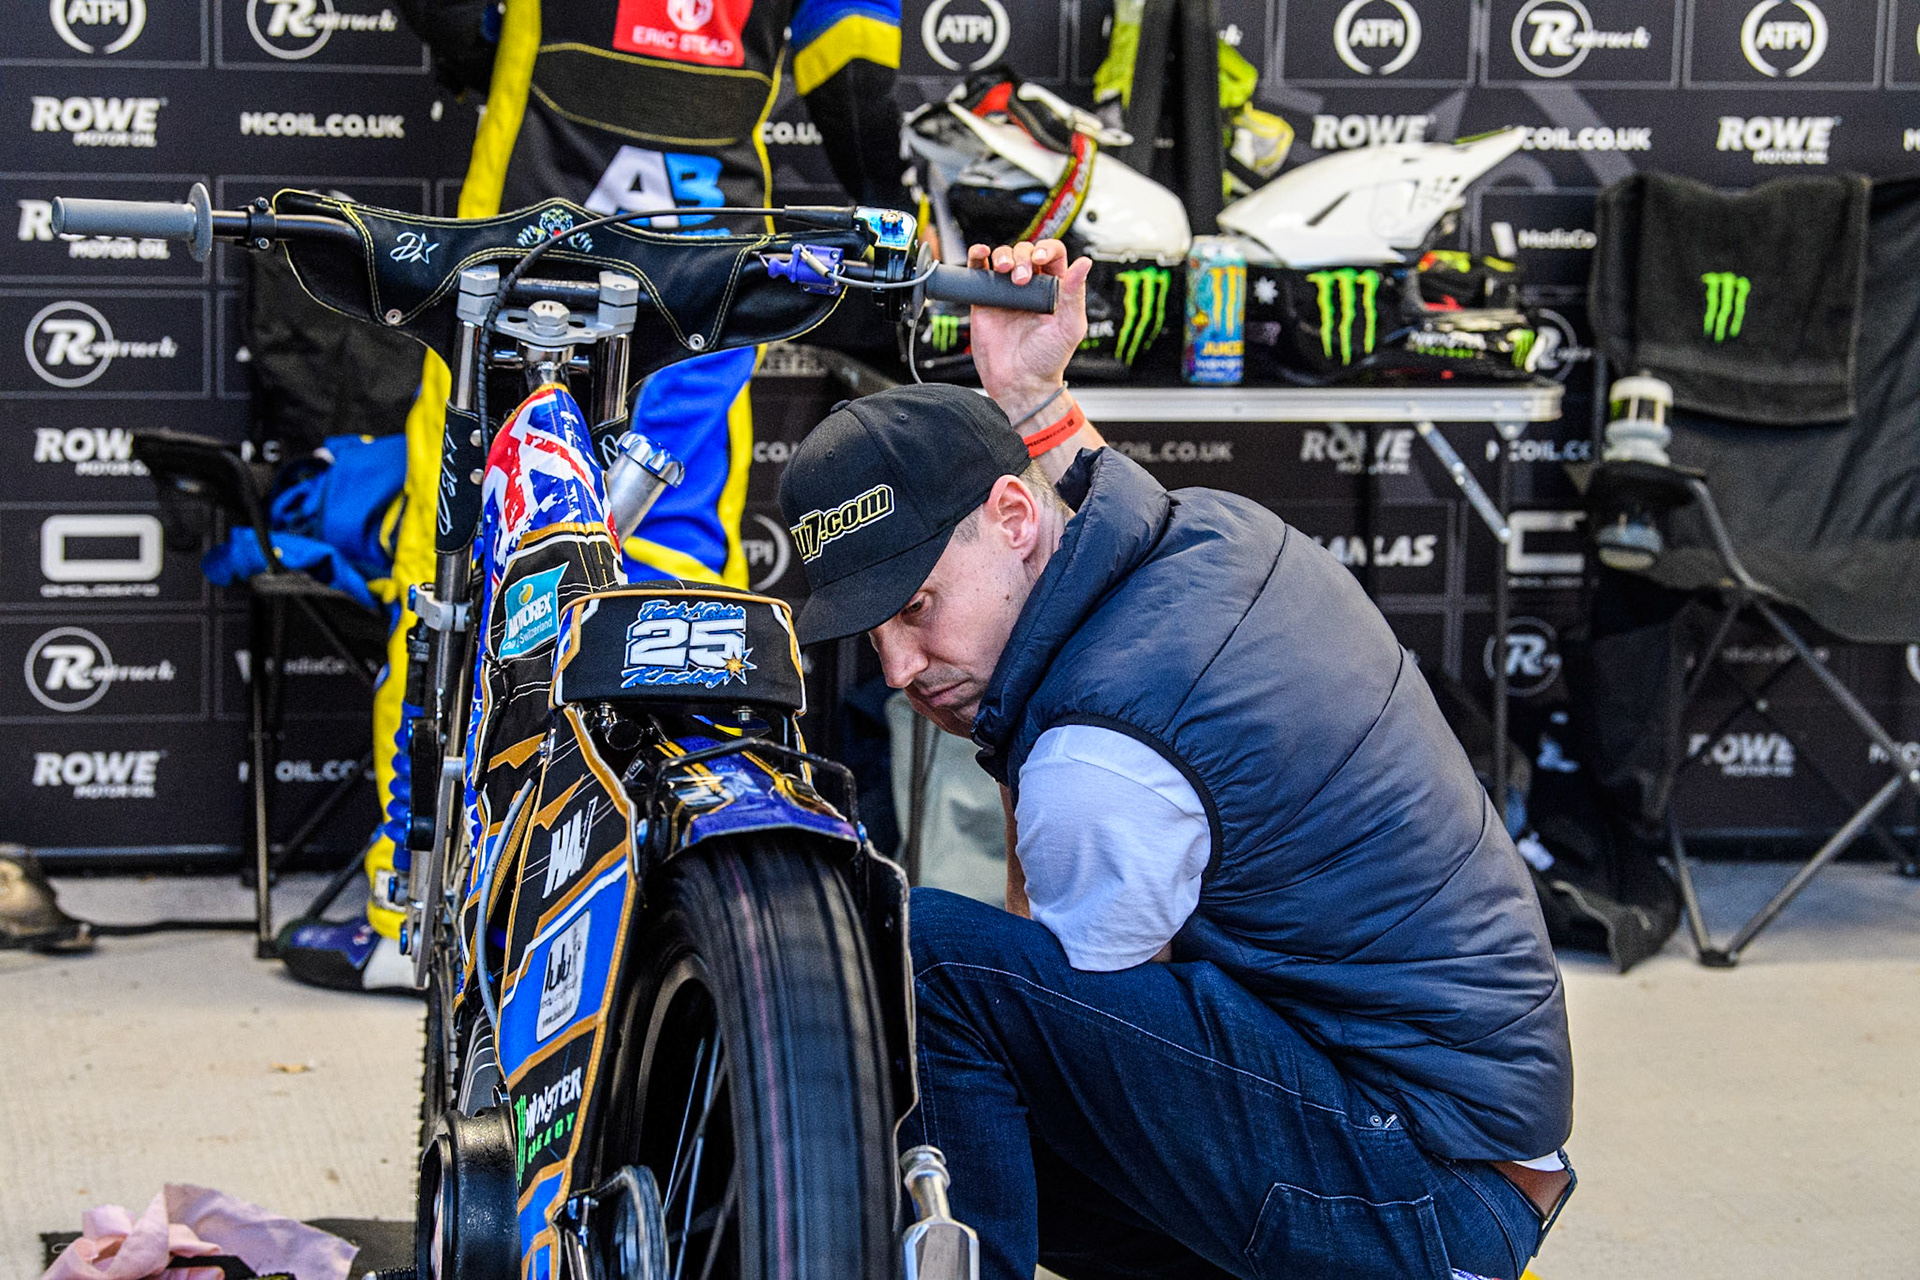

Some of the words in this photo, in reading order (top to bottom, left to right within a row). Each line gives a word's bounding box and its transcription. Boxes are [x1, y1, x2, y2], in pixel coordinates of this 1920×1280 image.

[632, 25, 678, 50] ERIC
[679, 33, 735, 57] STEAD
[937, 13, 993, 44] ATPI
[1350, 18, 1405, 48] ATPI
[1755, 21, 1813, 51] ATPI
[30, 96, 161, 133] ROWE
[240, 111, 405, 139] MCOIL.CO.UK
[1311, 114, 1430, 149] ROWE
[1716, 116, 1834, 151] ROWE
[585, 145, 726, 229] AB
[69, 238, 138, 259] MOTOR
[138, 239, 171, 260] OIL
[1518, 228, 1598, 250] MediaCo
[624, 617, 746, 671] 25
[32, 752, 159, 787] ROWE
